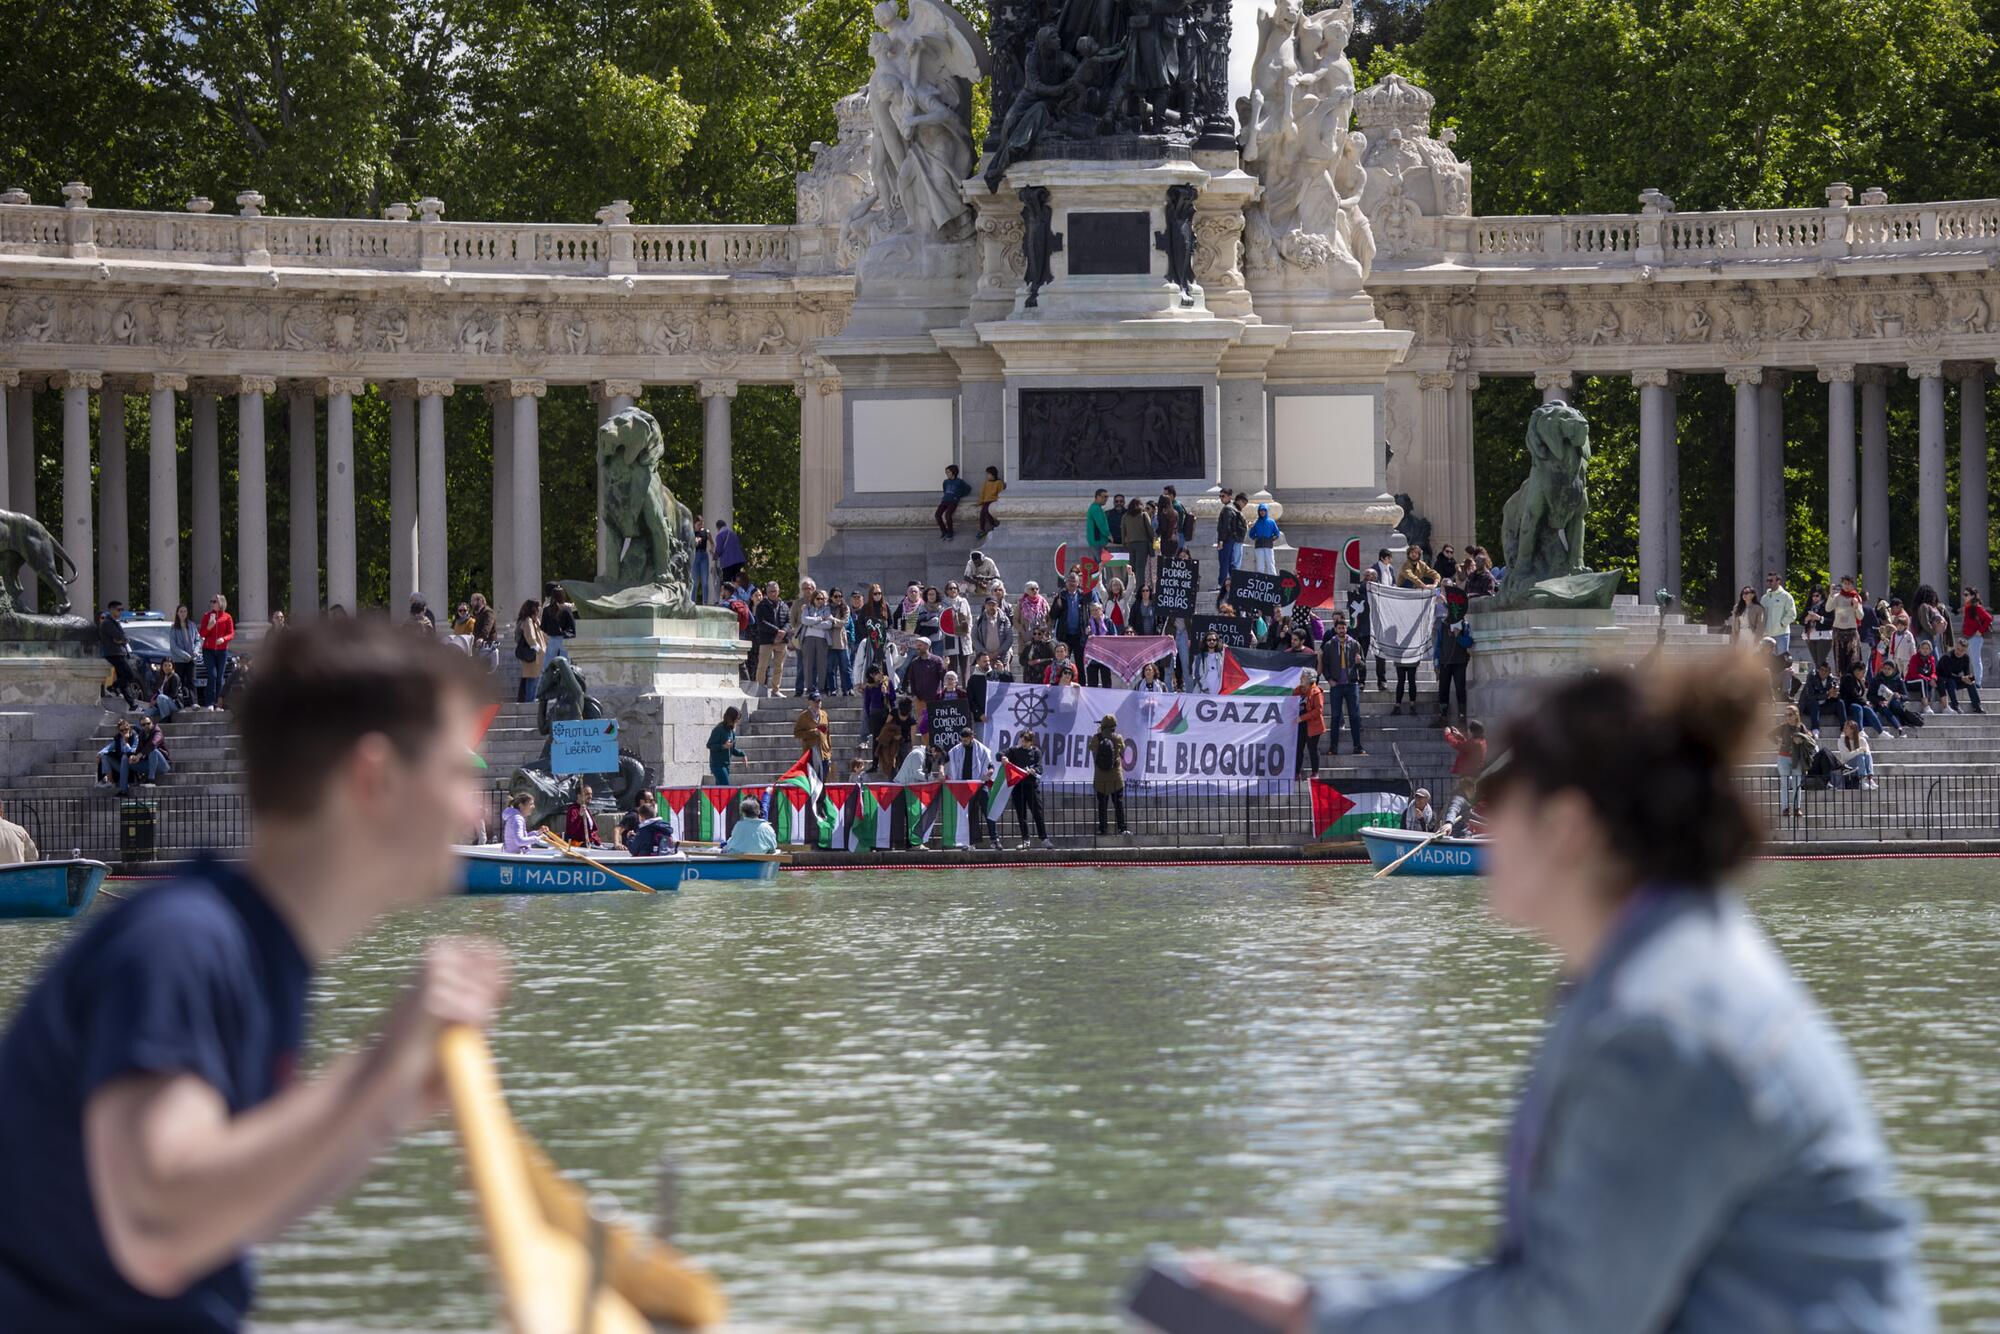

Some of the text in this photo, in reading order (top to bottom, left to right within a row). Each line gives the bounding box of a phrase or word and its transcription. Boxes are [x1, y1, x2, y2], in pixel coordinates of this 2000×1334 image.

[1171, 561, 1186, 569] NO
[1160, 578, 1179, 587] DECIR
[1247, 578, 1274, 592] STOP
[1163, 587, 1186, 597] NO LO
[1236, 588, 1281, 604] GENOCIDIO
[1208, 623, 1240, 634] ALTO EL
[1232, 634, 1245, 646] YA
[936, 707, 961, 716] FIN AL
[1195, 699, 1284, 724] GAZA
[933, 715, 967, 728] COMERCIO
[564, 727, 599, 738] FLOTILLA
[934, 731, 961, 746] ARMA
[565, 745, 602, 755] LIBERTAD
[1145, 740, 1167, 774] EL
[1175, 741, 1285, 777] BLOQUEO
[1412, 848, 1471, 865] MADRID
[526, 869, 607, 886] MADRID
